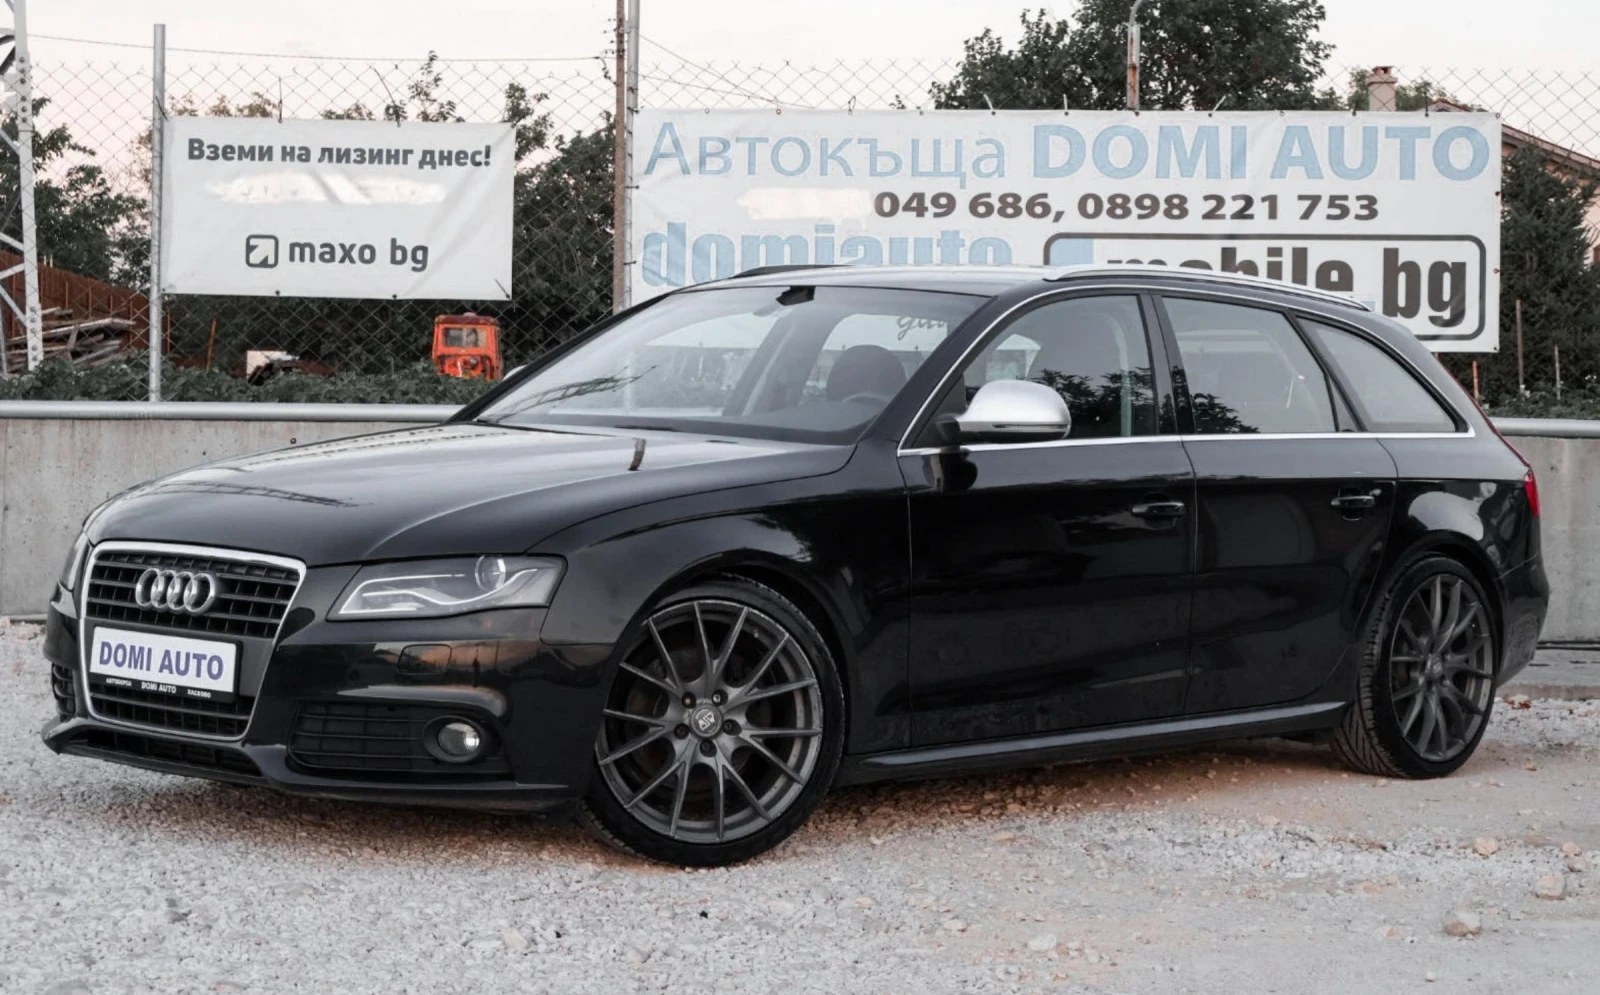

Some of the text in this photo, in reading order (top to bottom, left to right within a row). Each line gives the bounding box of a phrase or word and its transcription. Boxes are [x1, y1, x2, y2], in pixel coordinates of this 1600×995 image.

[187, 138, 492, 170] Вземи на лизинг днес!
[644, 121, 1491, 189] Автокъща DOMI AUTO
[873, 191, 1379, 223] 049 686, 0898 221 753
[288, 237, 429, 272] maxo bg
[99, 640, 224, 681] DOMI AUTO
[141, 681, 158, 692] DOMI
[158, 683, 177, 694] AUTO
